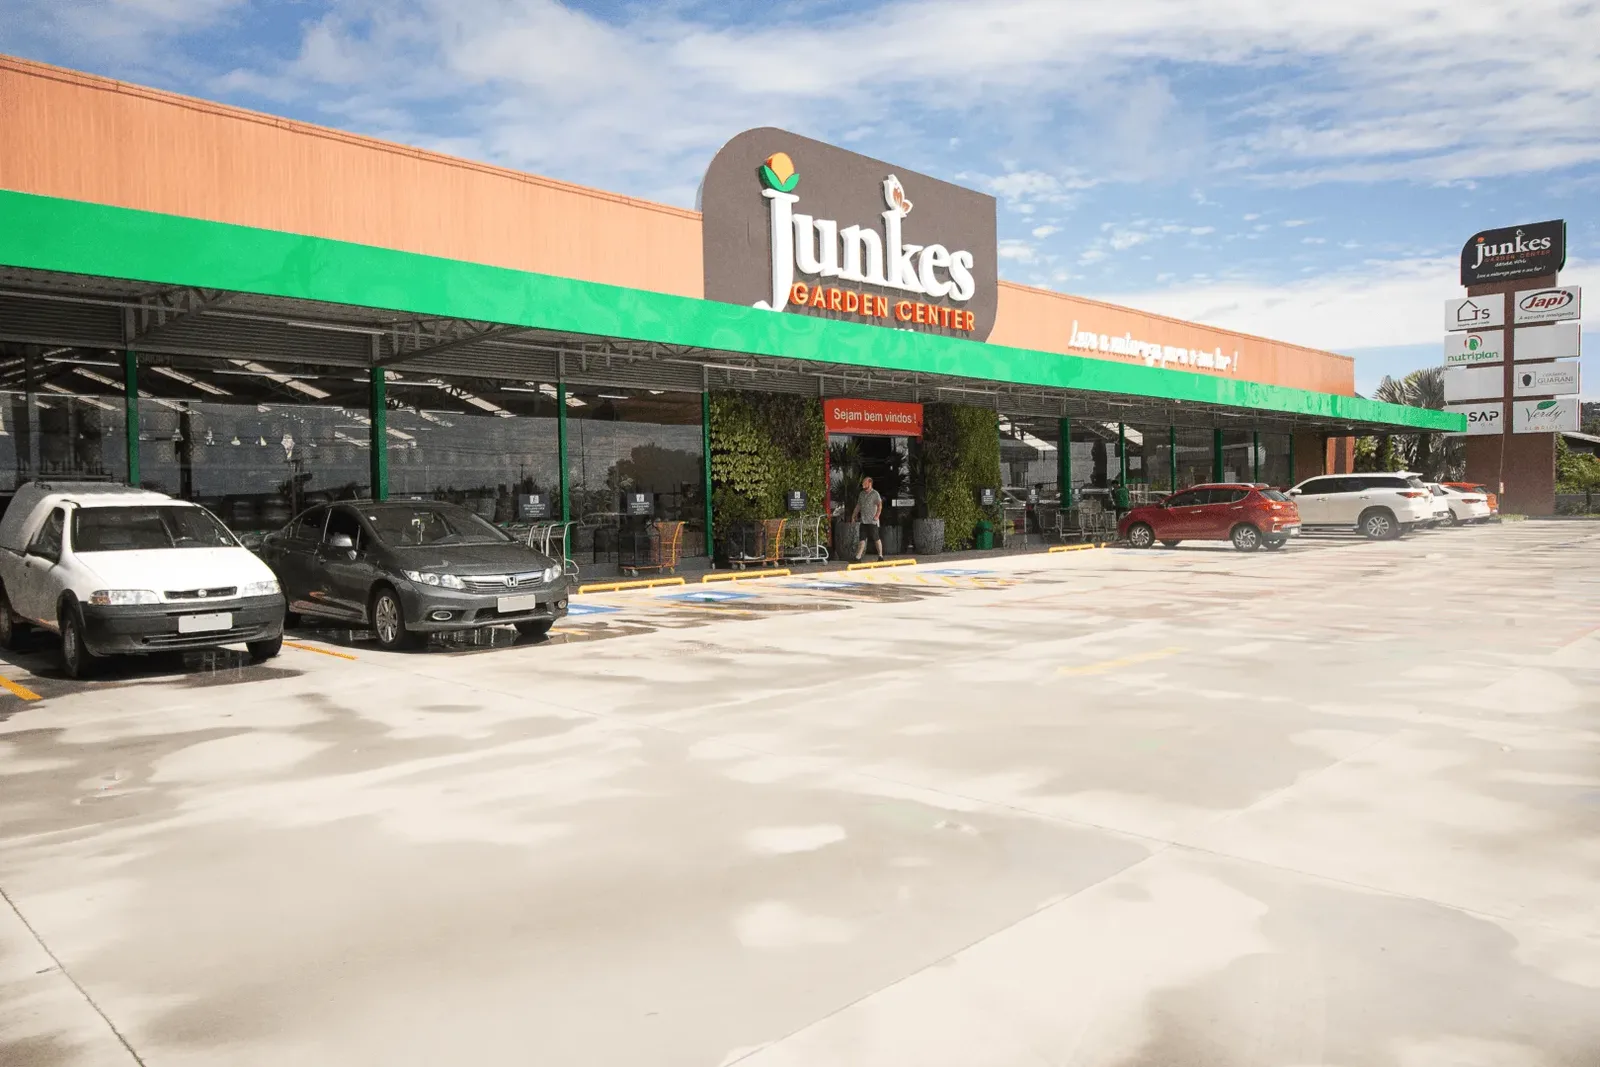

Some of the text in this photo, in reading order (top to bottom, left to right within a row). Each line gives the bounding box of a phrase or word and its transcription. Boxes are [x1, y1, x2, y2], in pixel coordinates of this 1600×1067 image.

[1484, 250, 1552, 263] GARDEN CENTER
[789, 282, 976, 332] GARDEN CENTER
[1525, 290, 1567, 309] Japi
[1447, 351, 1499, 362] nutriplan
[1537, 376, 1574, 384] GUARANI
[833, 408, 862, 423] Sejam
[864, 410, 883, 422] bem
[885, 411, 912, 424] vindos
[1525, 405, 1563, 422] Verdy
